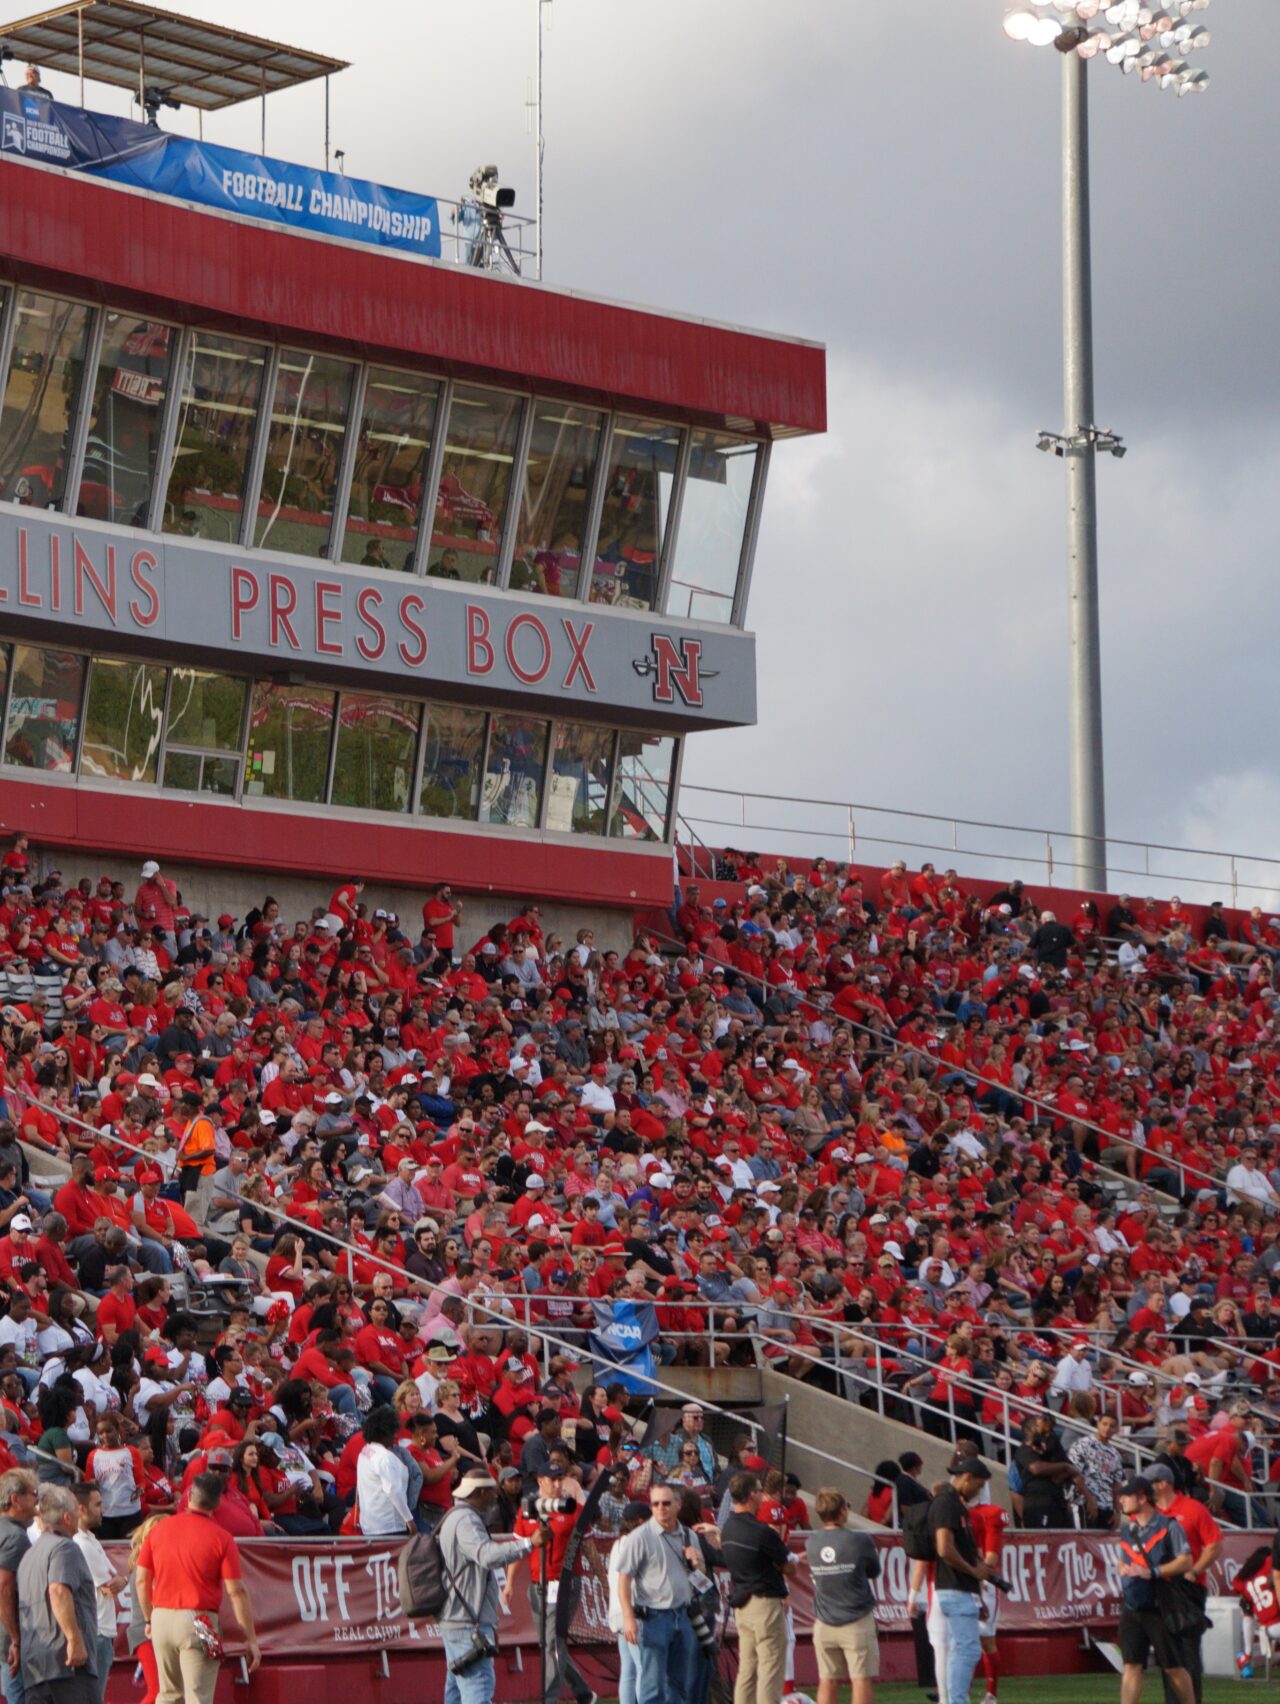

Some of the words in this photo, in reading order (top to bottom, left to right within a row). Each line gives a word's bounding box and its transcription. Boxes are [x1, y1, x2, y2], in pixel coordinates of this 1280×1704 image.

[26, 126, 69, 148] FOOTBALL
[26, 140, 71, 159] CHAMPIONSHIP
[222, 170, 303, 212] FOOTBALL
[308, 188, 431, 242] CHAMPIONSHIP
[231, 566, 429, 668] PRESS
[465, 603, 598, 693] BOX
[607, 1322, 642, 1340] NCAA
[291, 1554, 355, 1622] OFF
[1002, 1543, 1049, 1602] OFF
[1057, 1541, 1106, 1602] The
[333, 1626, 365, 1641] REAL
